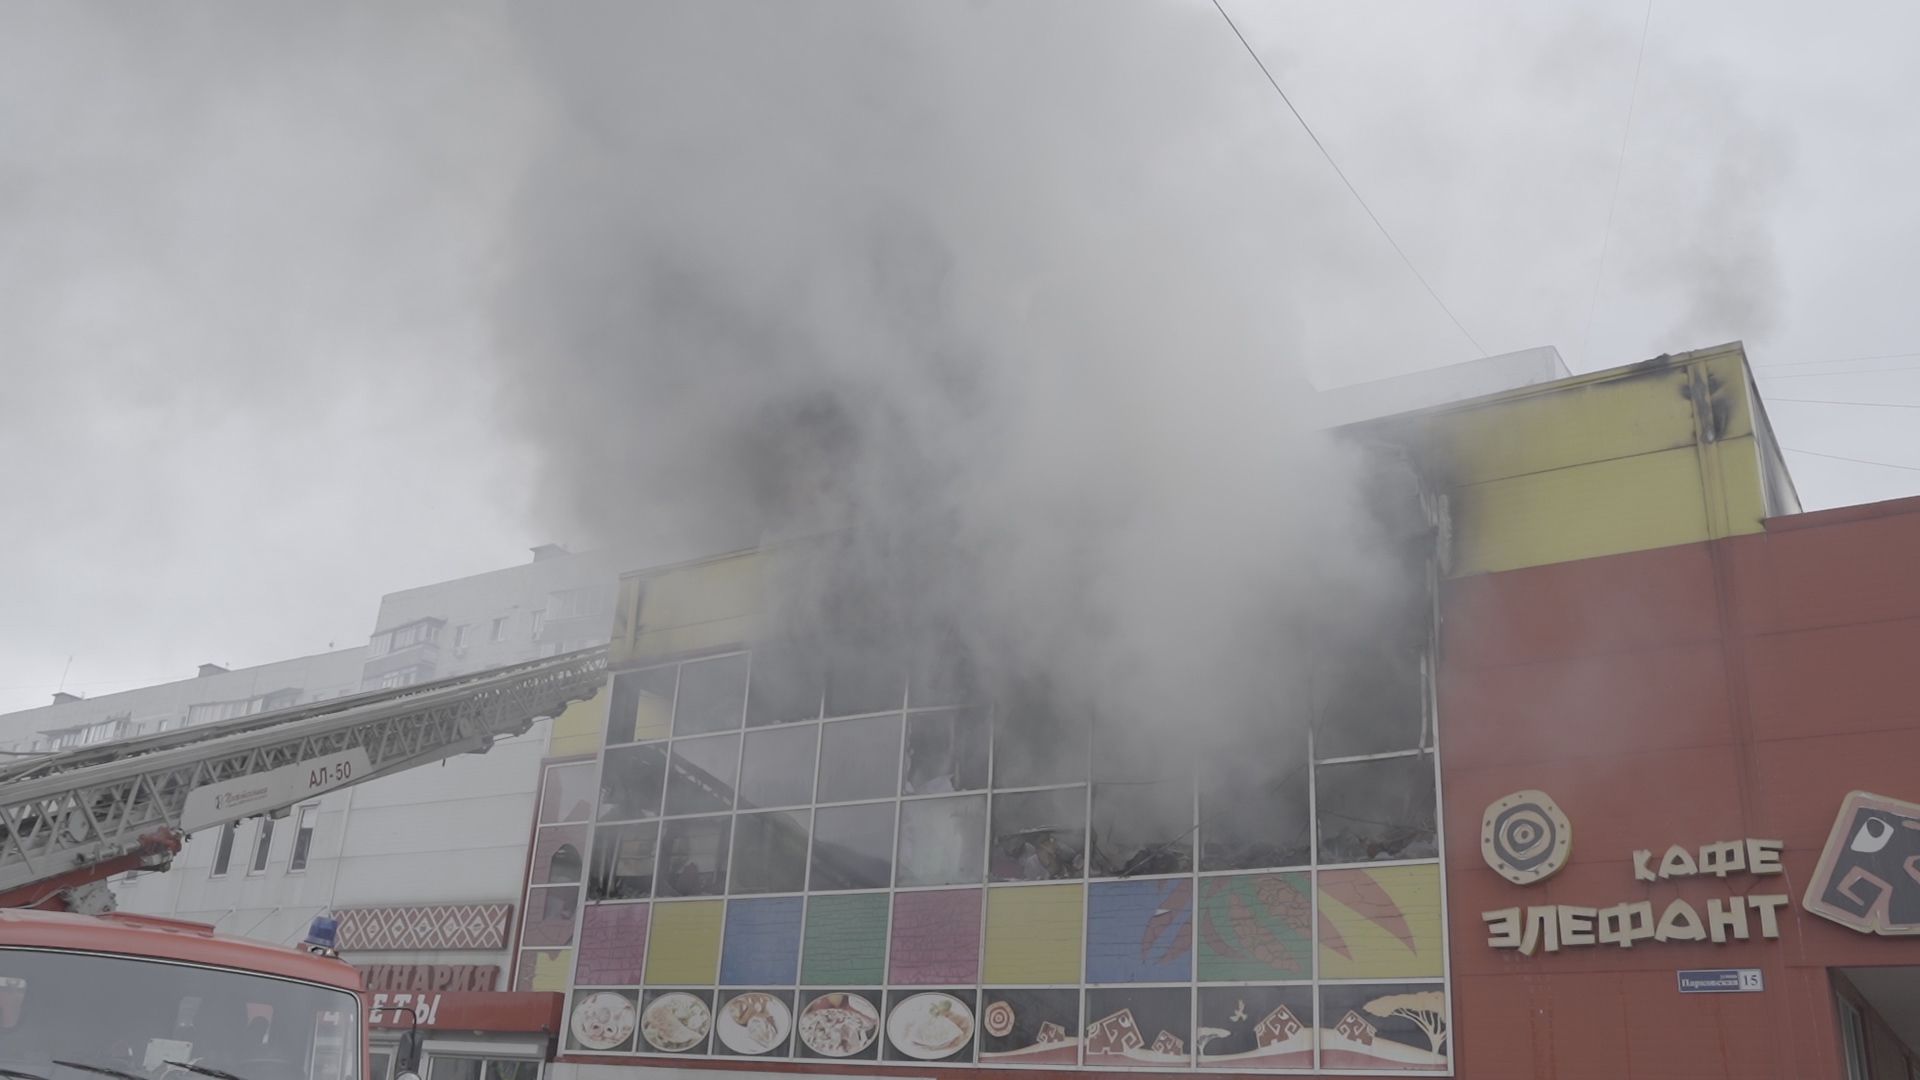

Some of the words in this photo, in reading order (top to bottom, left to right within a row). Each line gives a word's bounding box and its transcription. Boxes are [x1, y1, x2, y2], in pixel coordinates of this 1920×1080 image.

[309, 760, 351, 788] АЛ-50
[1633, 839, 1783, 881] КАФЕ
[1482, 894, 1789, 956] ЭЛЕФАНТ
[1743, 974, 1758, 986] 15
